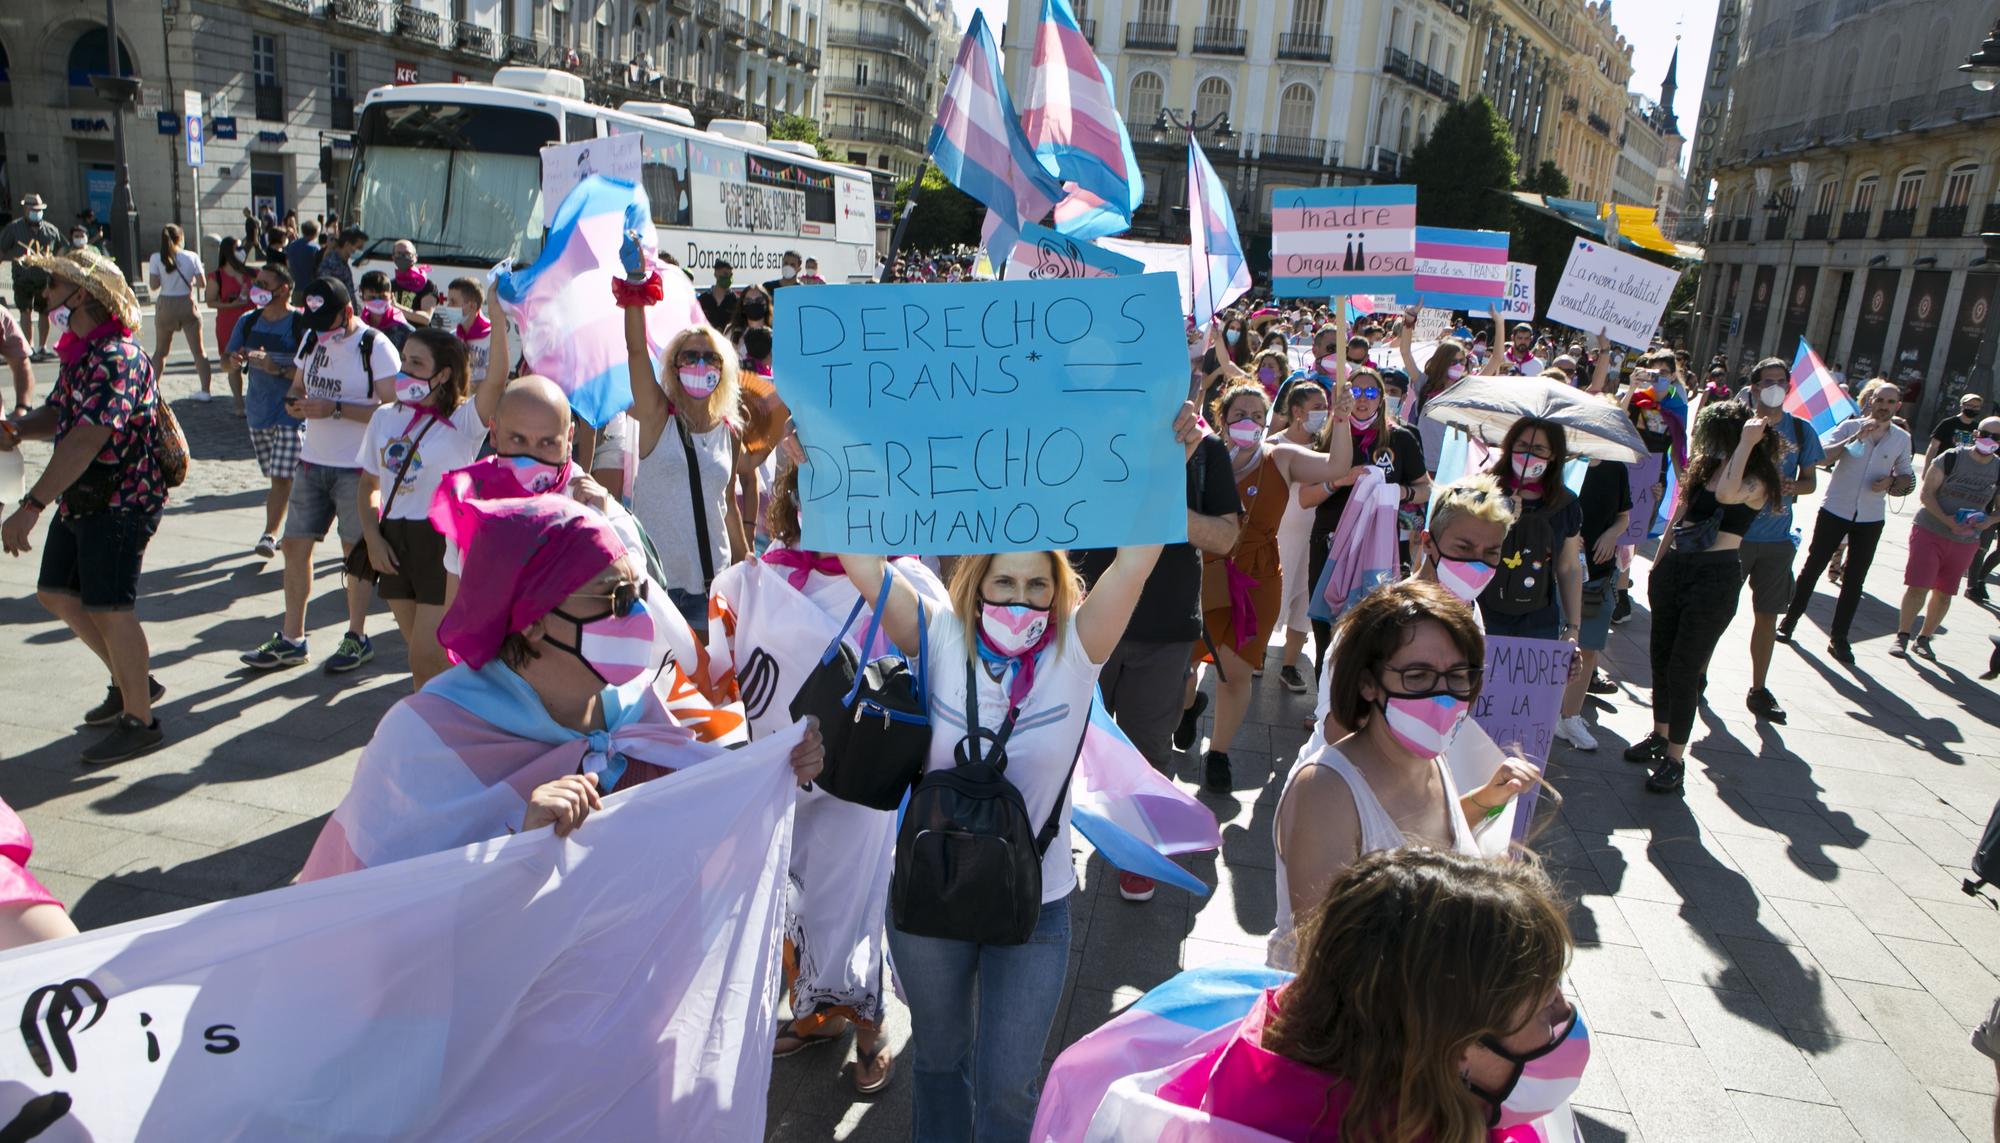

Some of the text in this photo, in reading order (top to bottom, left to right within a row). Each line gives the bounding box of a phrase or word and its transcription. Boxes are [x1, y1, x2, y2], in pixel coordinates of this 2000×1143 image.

[1709, 0, 1738, 88] HOTEL
[397, 67, 418, 83] KFC
[71, 117, 110, 132] BBVA
[726, 205, 743, 228] QUE
[751, 245, 764, 270] de
[1568, 255, 1586, 280] La
[1468, 263, 1501, 280] TRANS
[798, 293, 1146, 356] DERECHOS
[307, 374, 342, 392] TRANS
[804, 426, 1130, 502] DERECHOS
[847, 500, 1087, 547] HUMANOS
[1488, 647, 1569, 685] MADRES
[1475, 695, 1530, 718] DE LA
